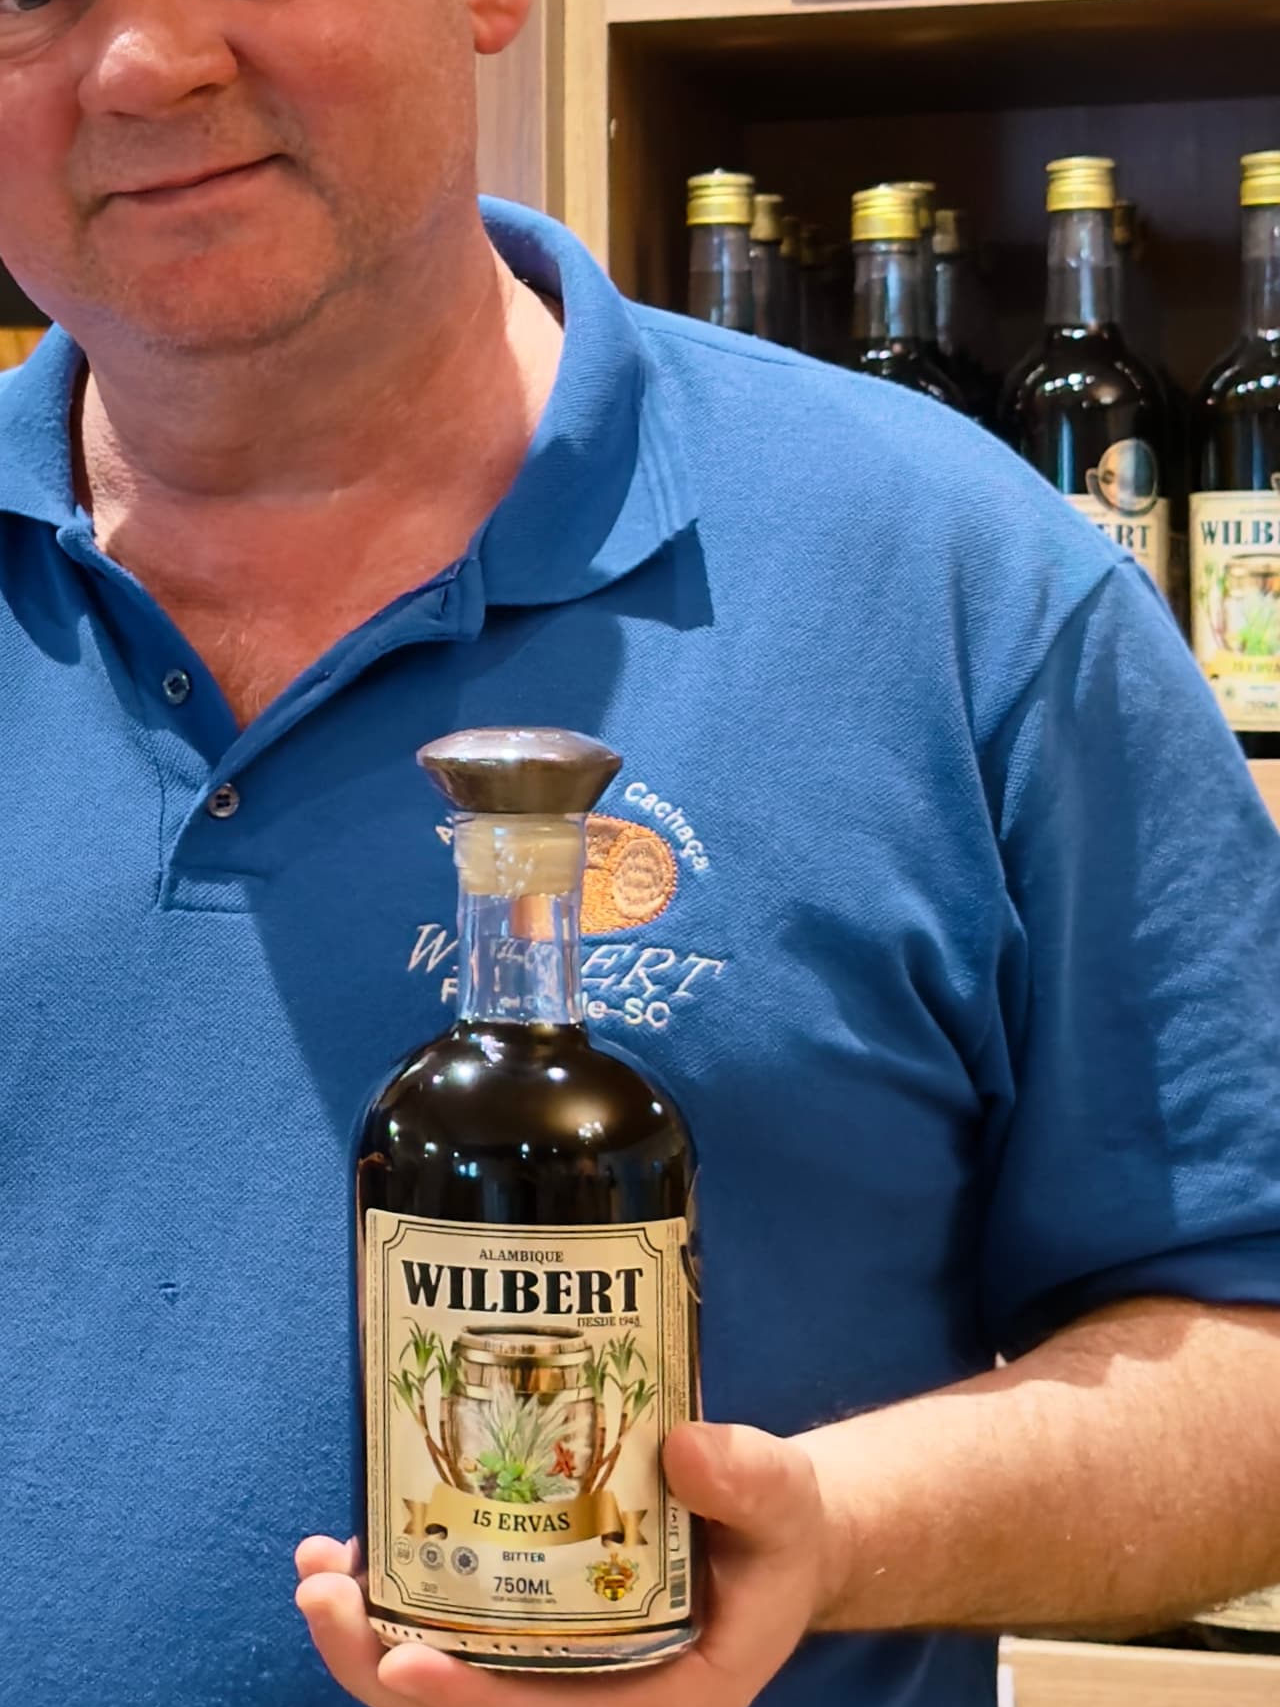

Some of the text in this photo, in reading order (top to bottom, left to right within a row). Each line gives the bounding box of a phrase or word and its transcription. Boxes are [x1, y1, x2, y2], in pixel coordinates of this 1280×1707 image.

[1201, 520, 1280, 545] WILB
[625, 781, 709, 871] Cachaça
[407, 922, 727, 999] WERT
[479, 1248, 564, 1265] ALAMBIQUE
[401, 1259, 644, 1315] WILBERT
[577, 1316, 616, 1327] DESDE
[472, 1507, 571, 1533] 15 ERVAS
[502, 1550, 545, 1562] BITTER
[493, 1576, 553, 1595] 750ML
